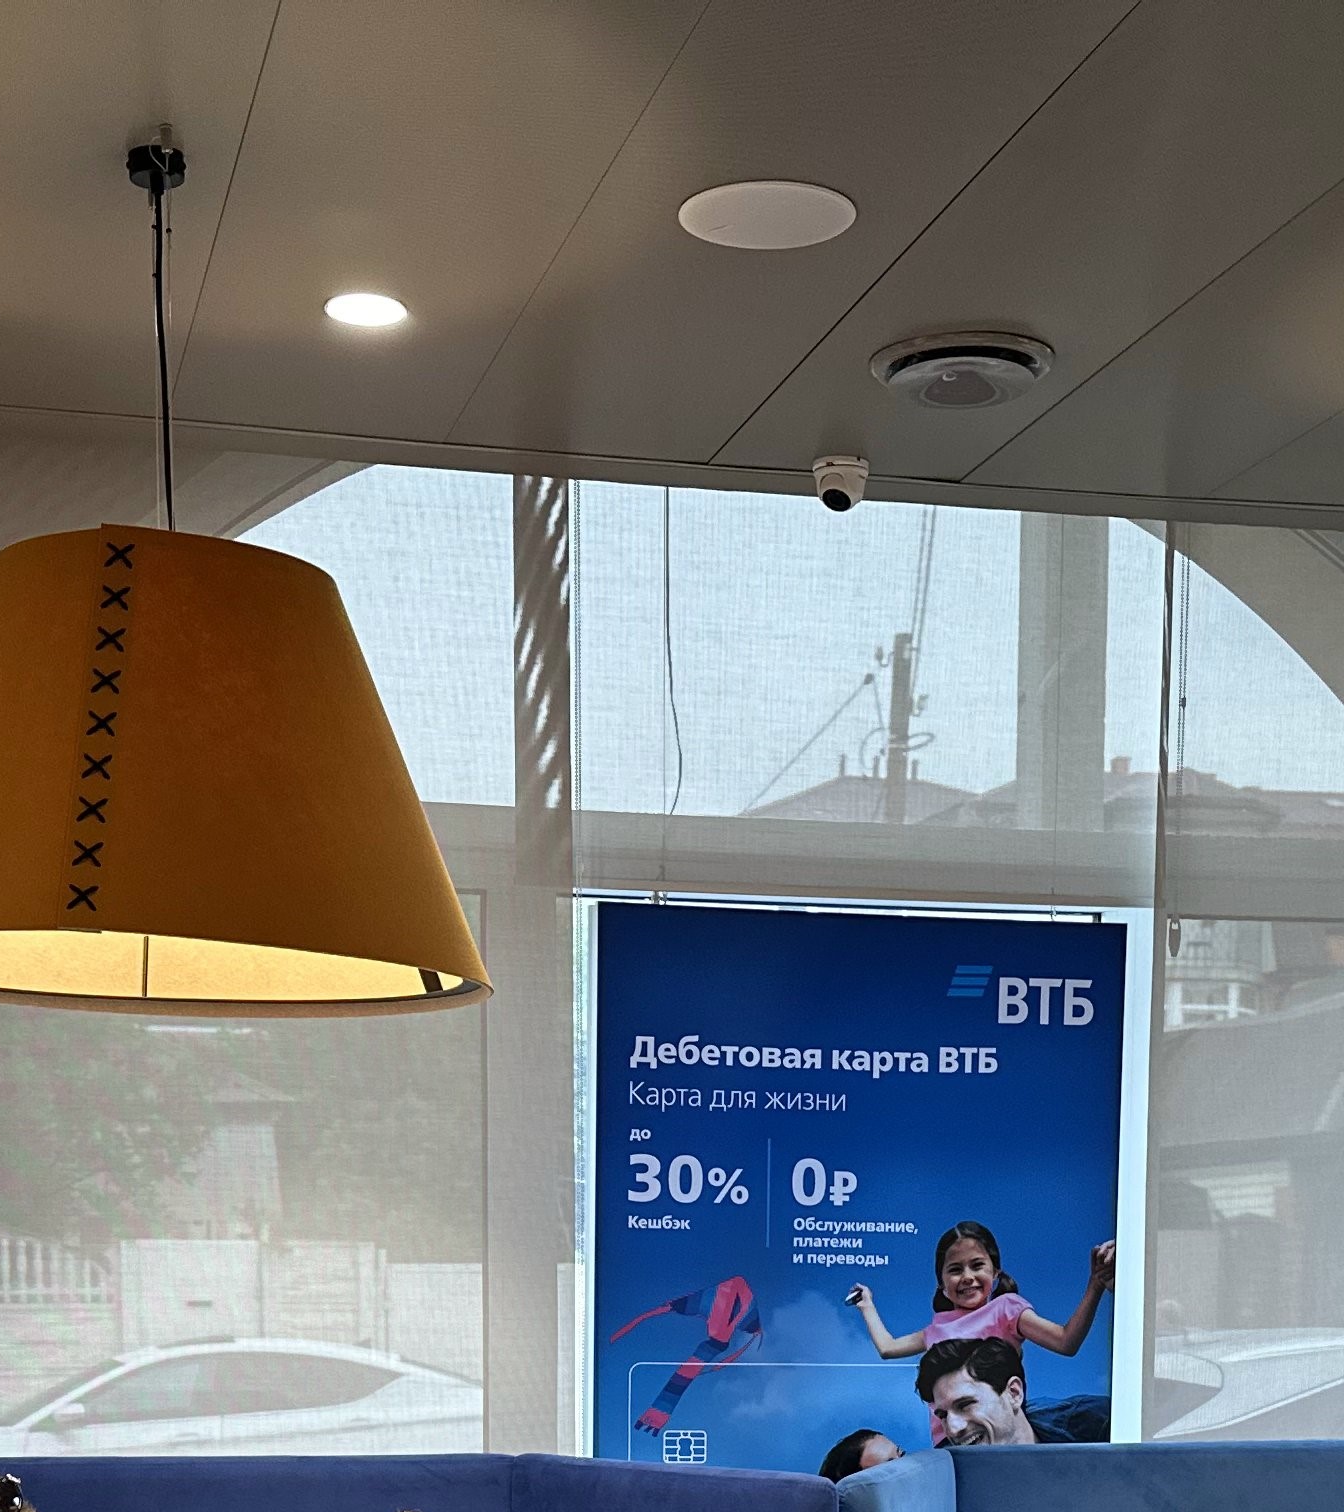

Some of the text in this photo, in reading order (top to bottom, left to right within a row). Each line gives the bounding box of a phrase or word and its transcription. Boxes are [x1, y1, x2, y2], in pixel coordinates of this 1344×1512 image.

[997, 976, 1095, 1026] ВТБ
[629, 1034, 998, 1079] Дебетовая карта ВТБ
[629, 1080, 846, 1112] Карта для жизни
[629, 1128, 652, 1141] до
[627, 1153, 750, 1205] 30%
[792, 1157, 858, 1206] 0₽
[627, 1214, 691, 1230] Кешбэк
[793, 1217, 919, 1235] Обслуживание,
[793, 1236, 863, 1249] платежи
[793, 1253, 889, 1268] и переводы
